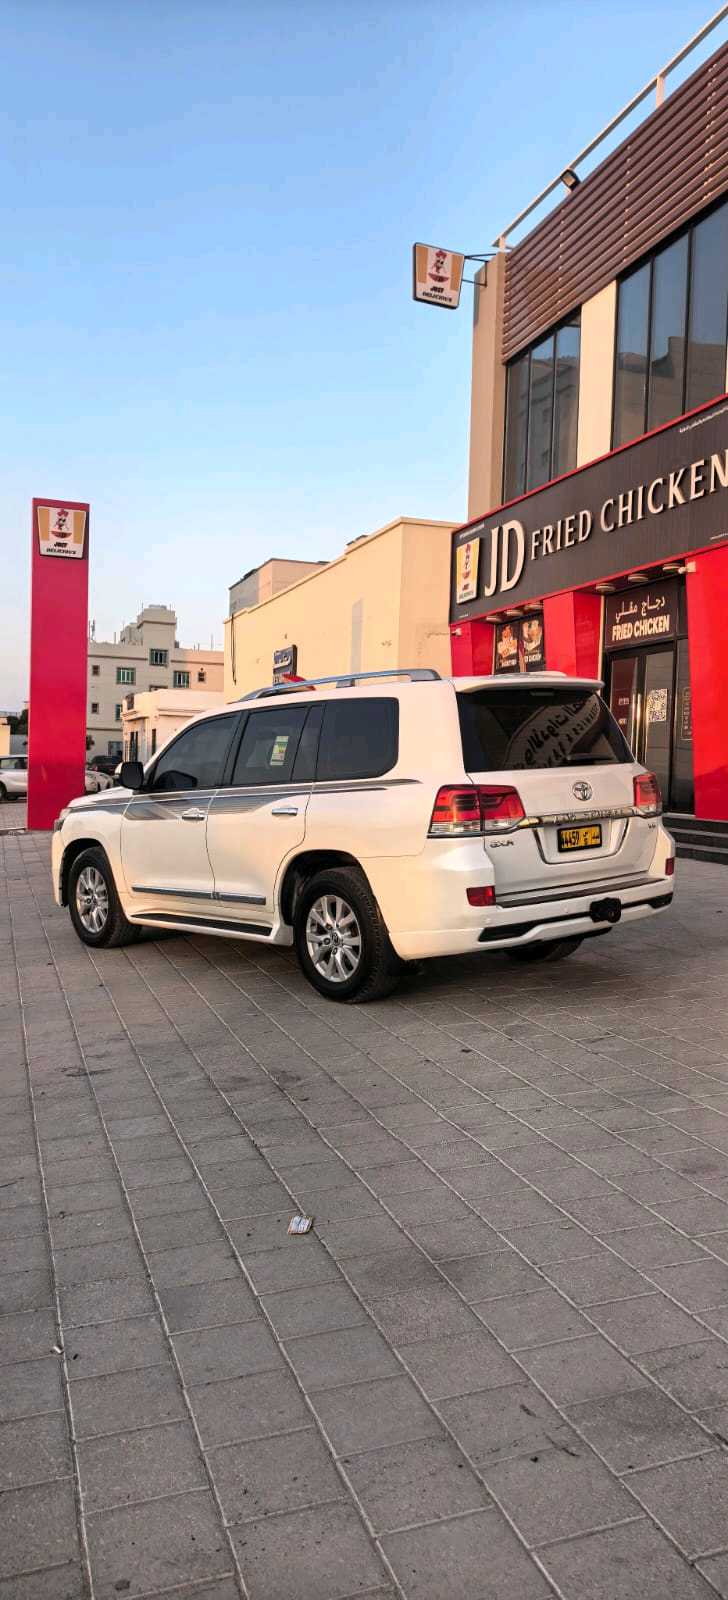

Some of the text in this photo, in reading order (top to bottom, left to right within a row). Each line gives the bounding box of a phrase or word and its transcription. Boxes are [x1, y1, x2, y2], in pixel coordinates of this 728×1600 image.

[484, 449, 728, 597] JD FRIED CHICKEN
[615, 594, 666, 624] دجاج مقلي
[611, 614, 671, 641] FRIED CHICKEN
